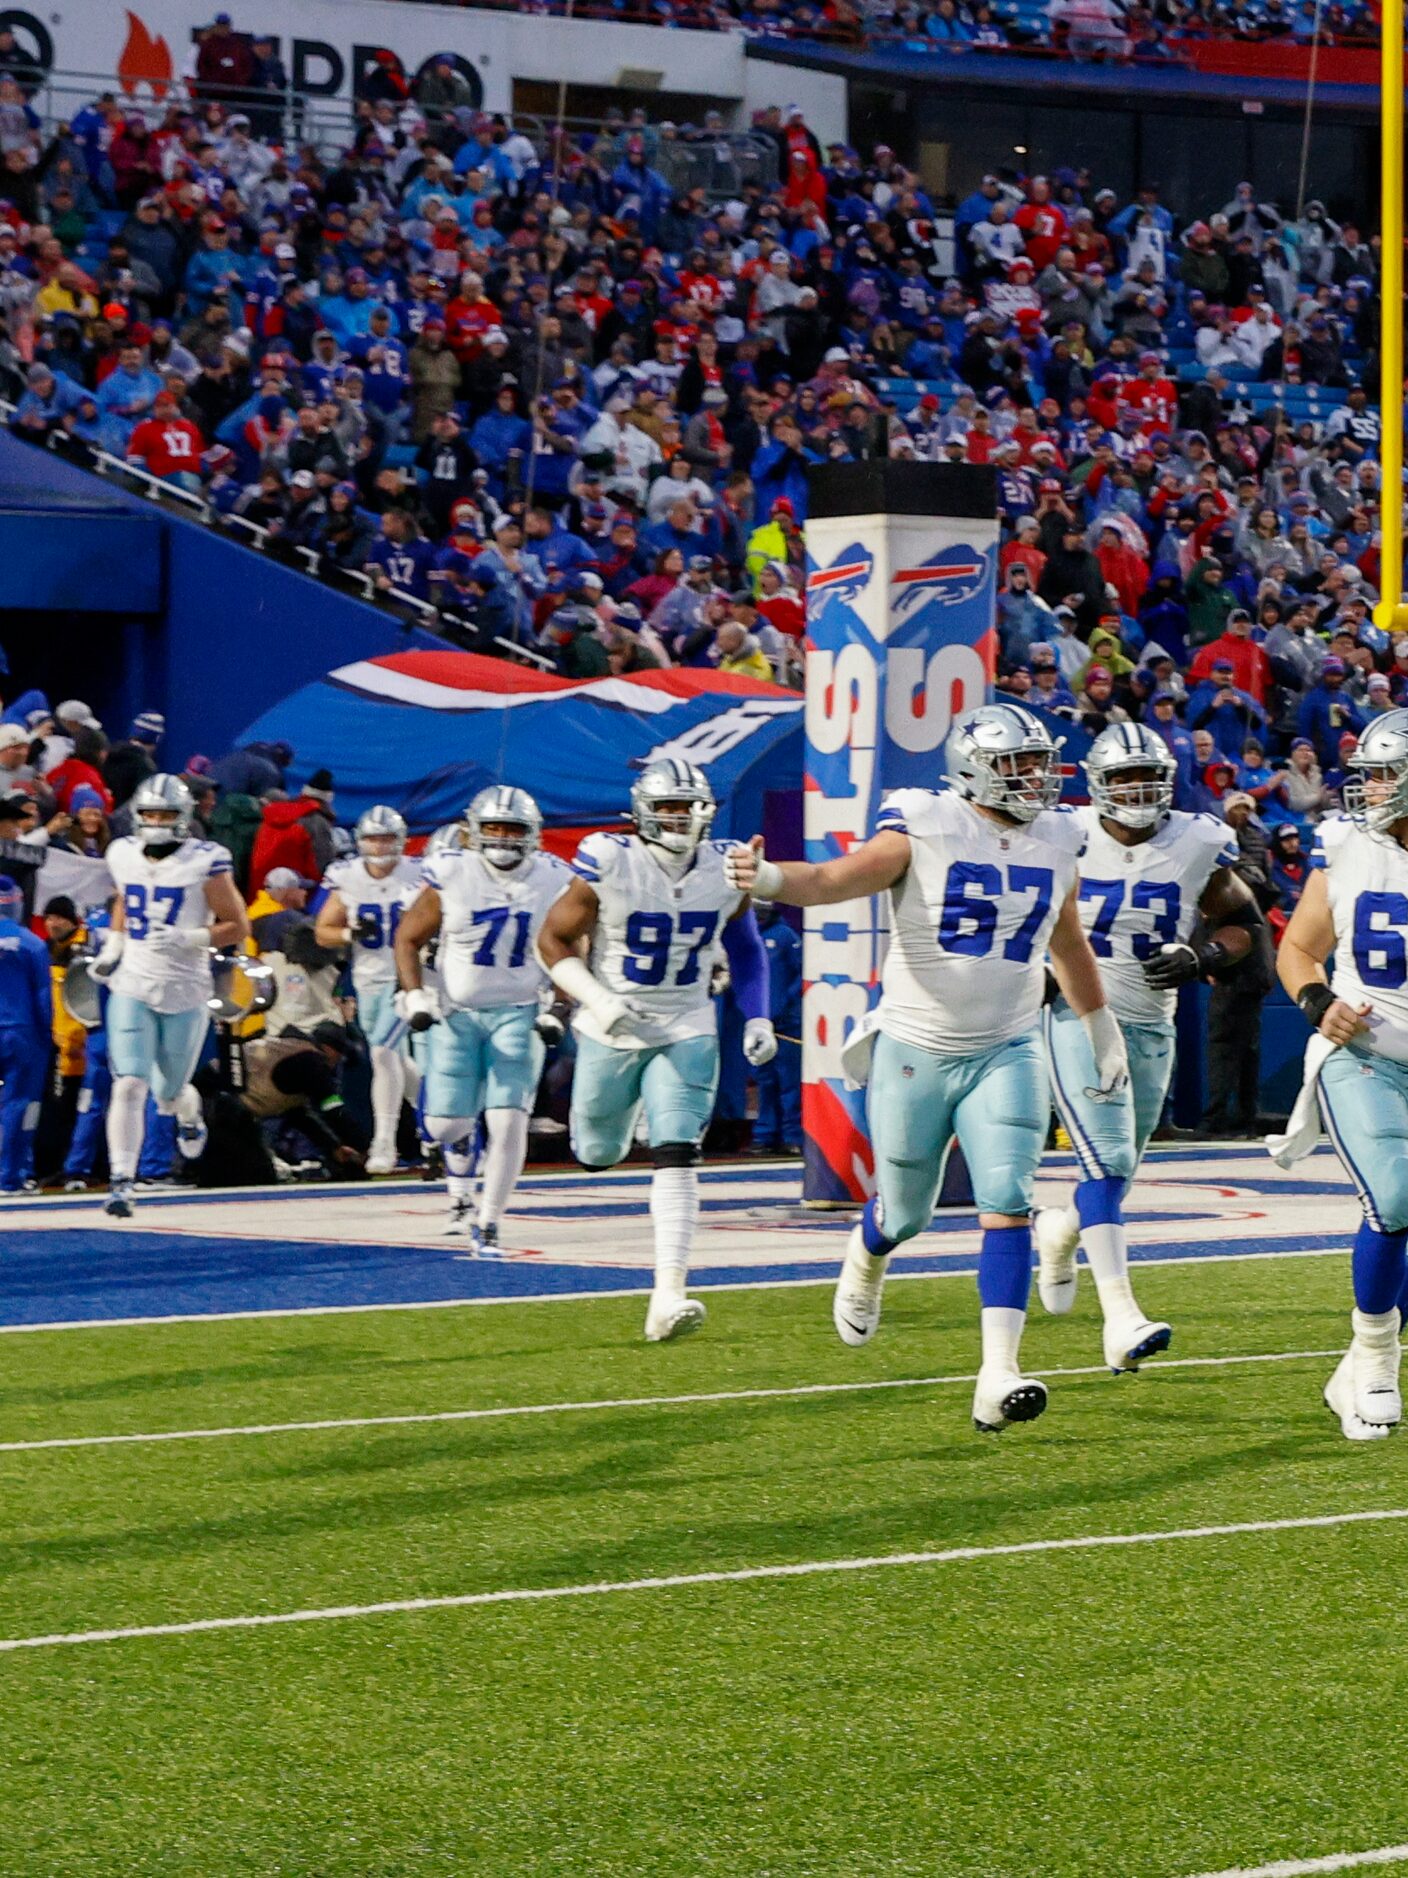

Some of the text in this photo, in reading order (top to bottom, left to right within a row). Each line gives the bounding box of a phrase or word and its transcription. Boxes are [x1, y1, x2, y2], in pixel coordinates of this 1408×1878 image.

[161, 430, 192, 457] 17
[387, 557, 415, 585] 17
[125, 884, 184, 940] 87
[471, 907, 532, 967] 71
[937, 860, 1054, 964] 67
[1078, 876, 1182, 962] 73
[623, 910, 720, 985] 97
